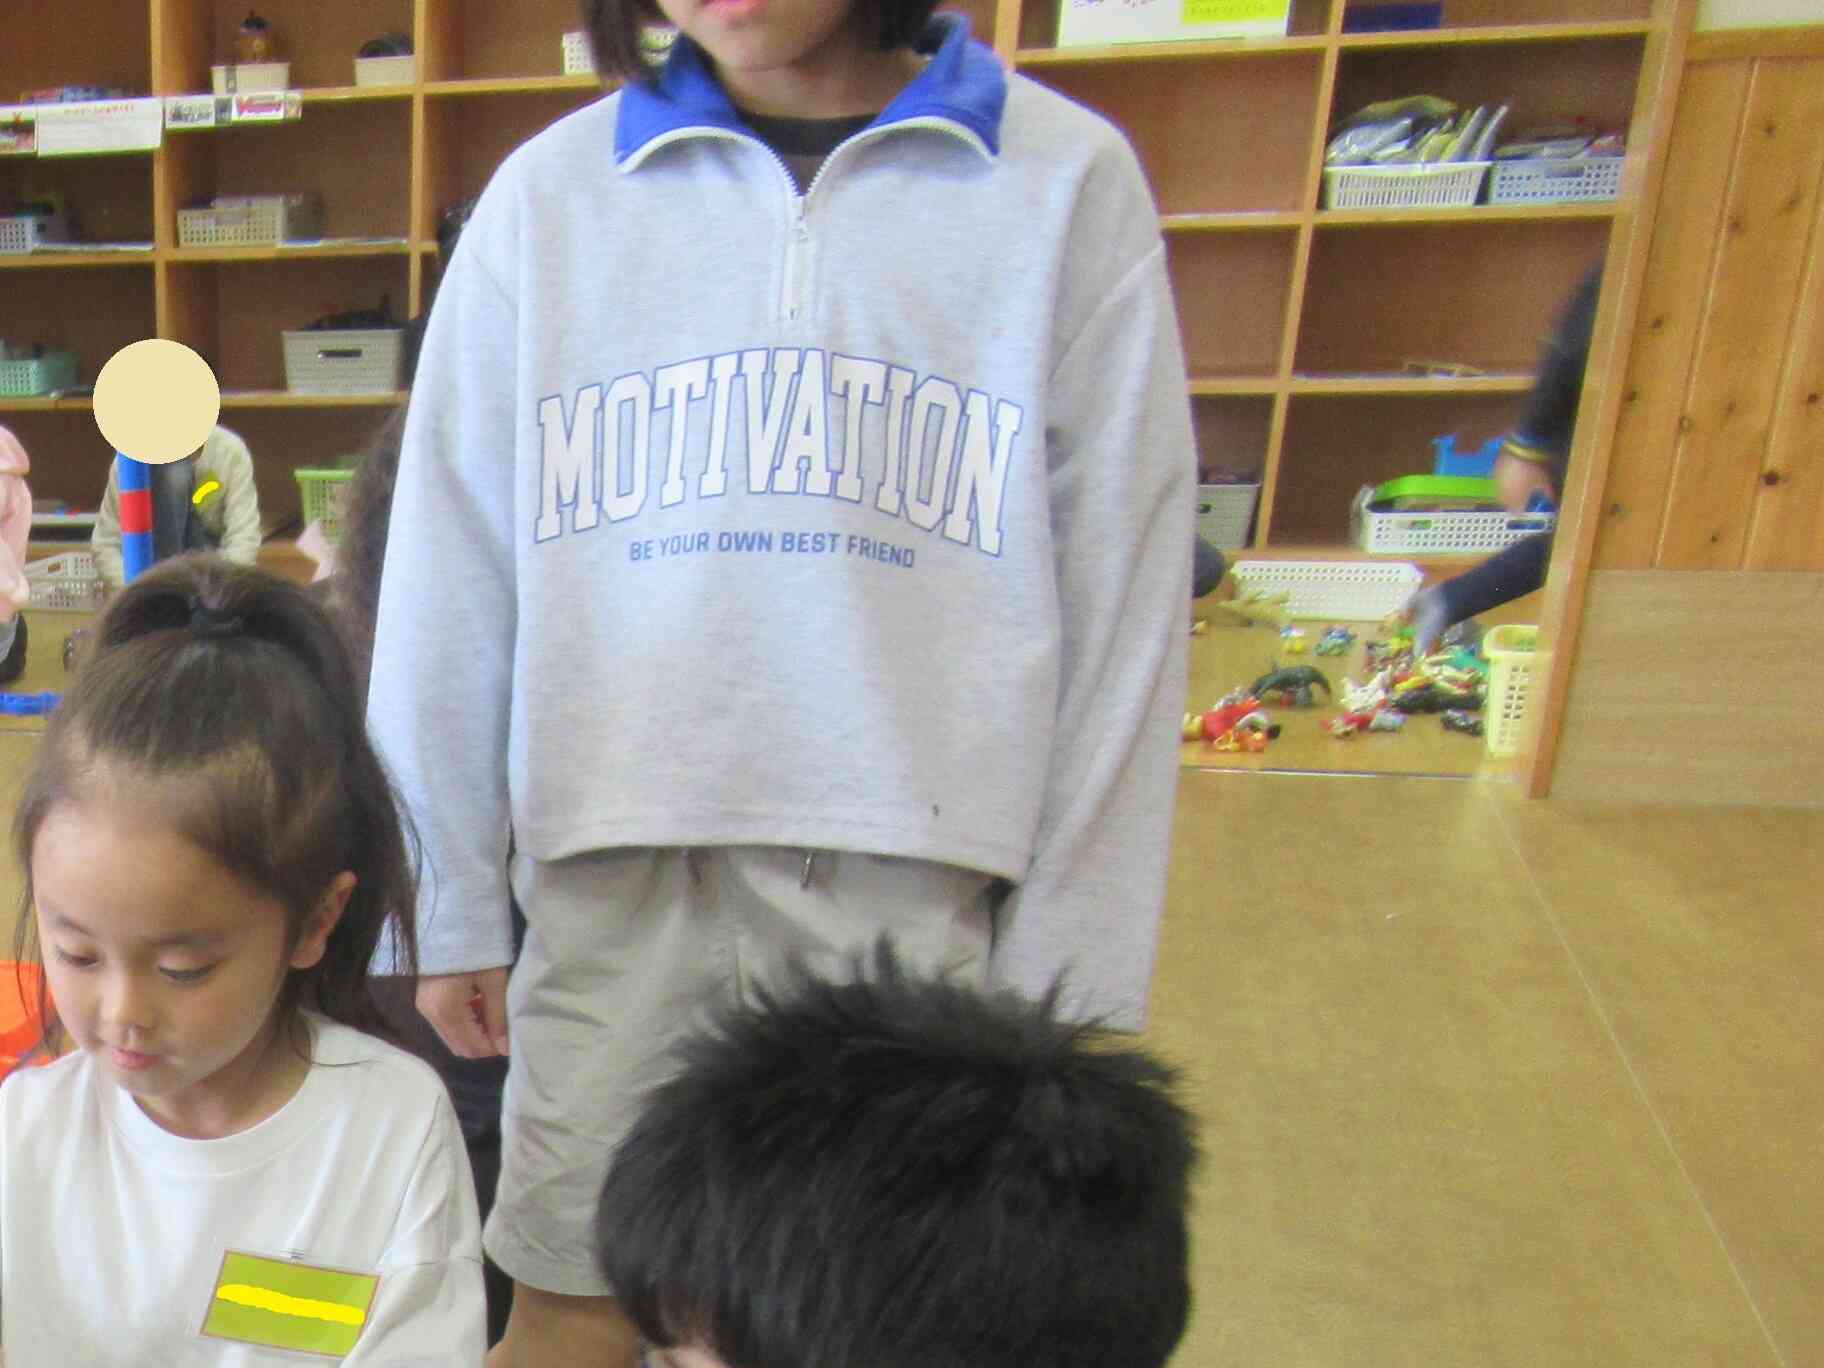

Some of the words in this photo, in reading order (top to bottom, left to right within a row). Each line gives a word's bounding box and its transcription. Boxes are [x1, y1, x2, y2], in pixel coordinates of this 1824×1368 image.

[535, 347, 1023, 558] MOTIVATION
[630, 540, 653, 561] BE
[659, 532, 710, 556] YOUR
[718, 532, 772, 553] OWN
[780, 532, 840, 553] BEST
[847, 535, 915, 568] FRIEND
